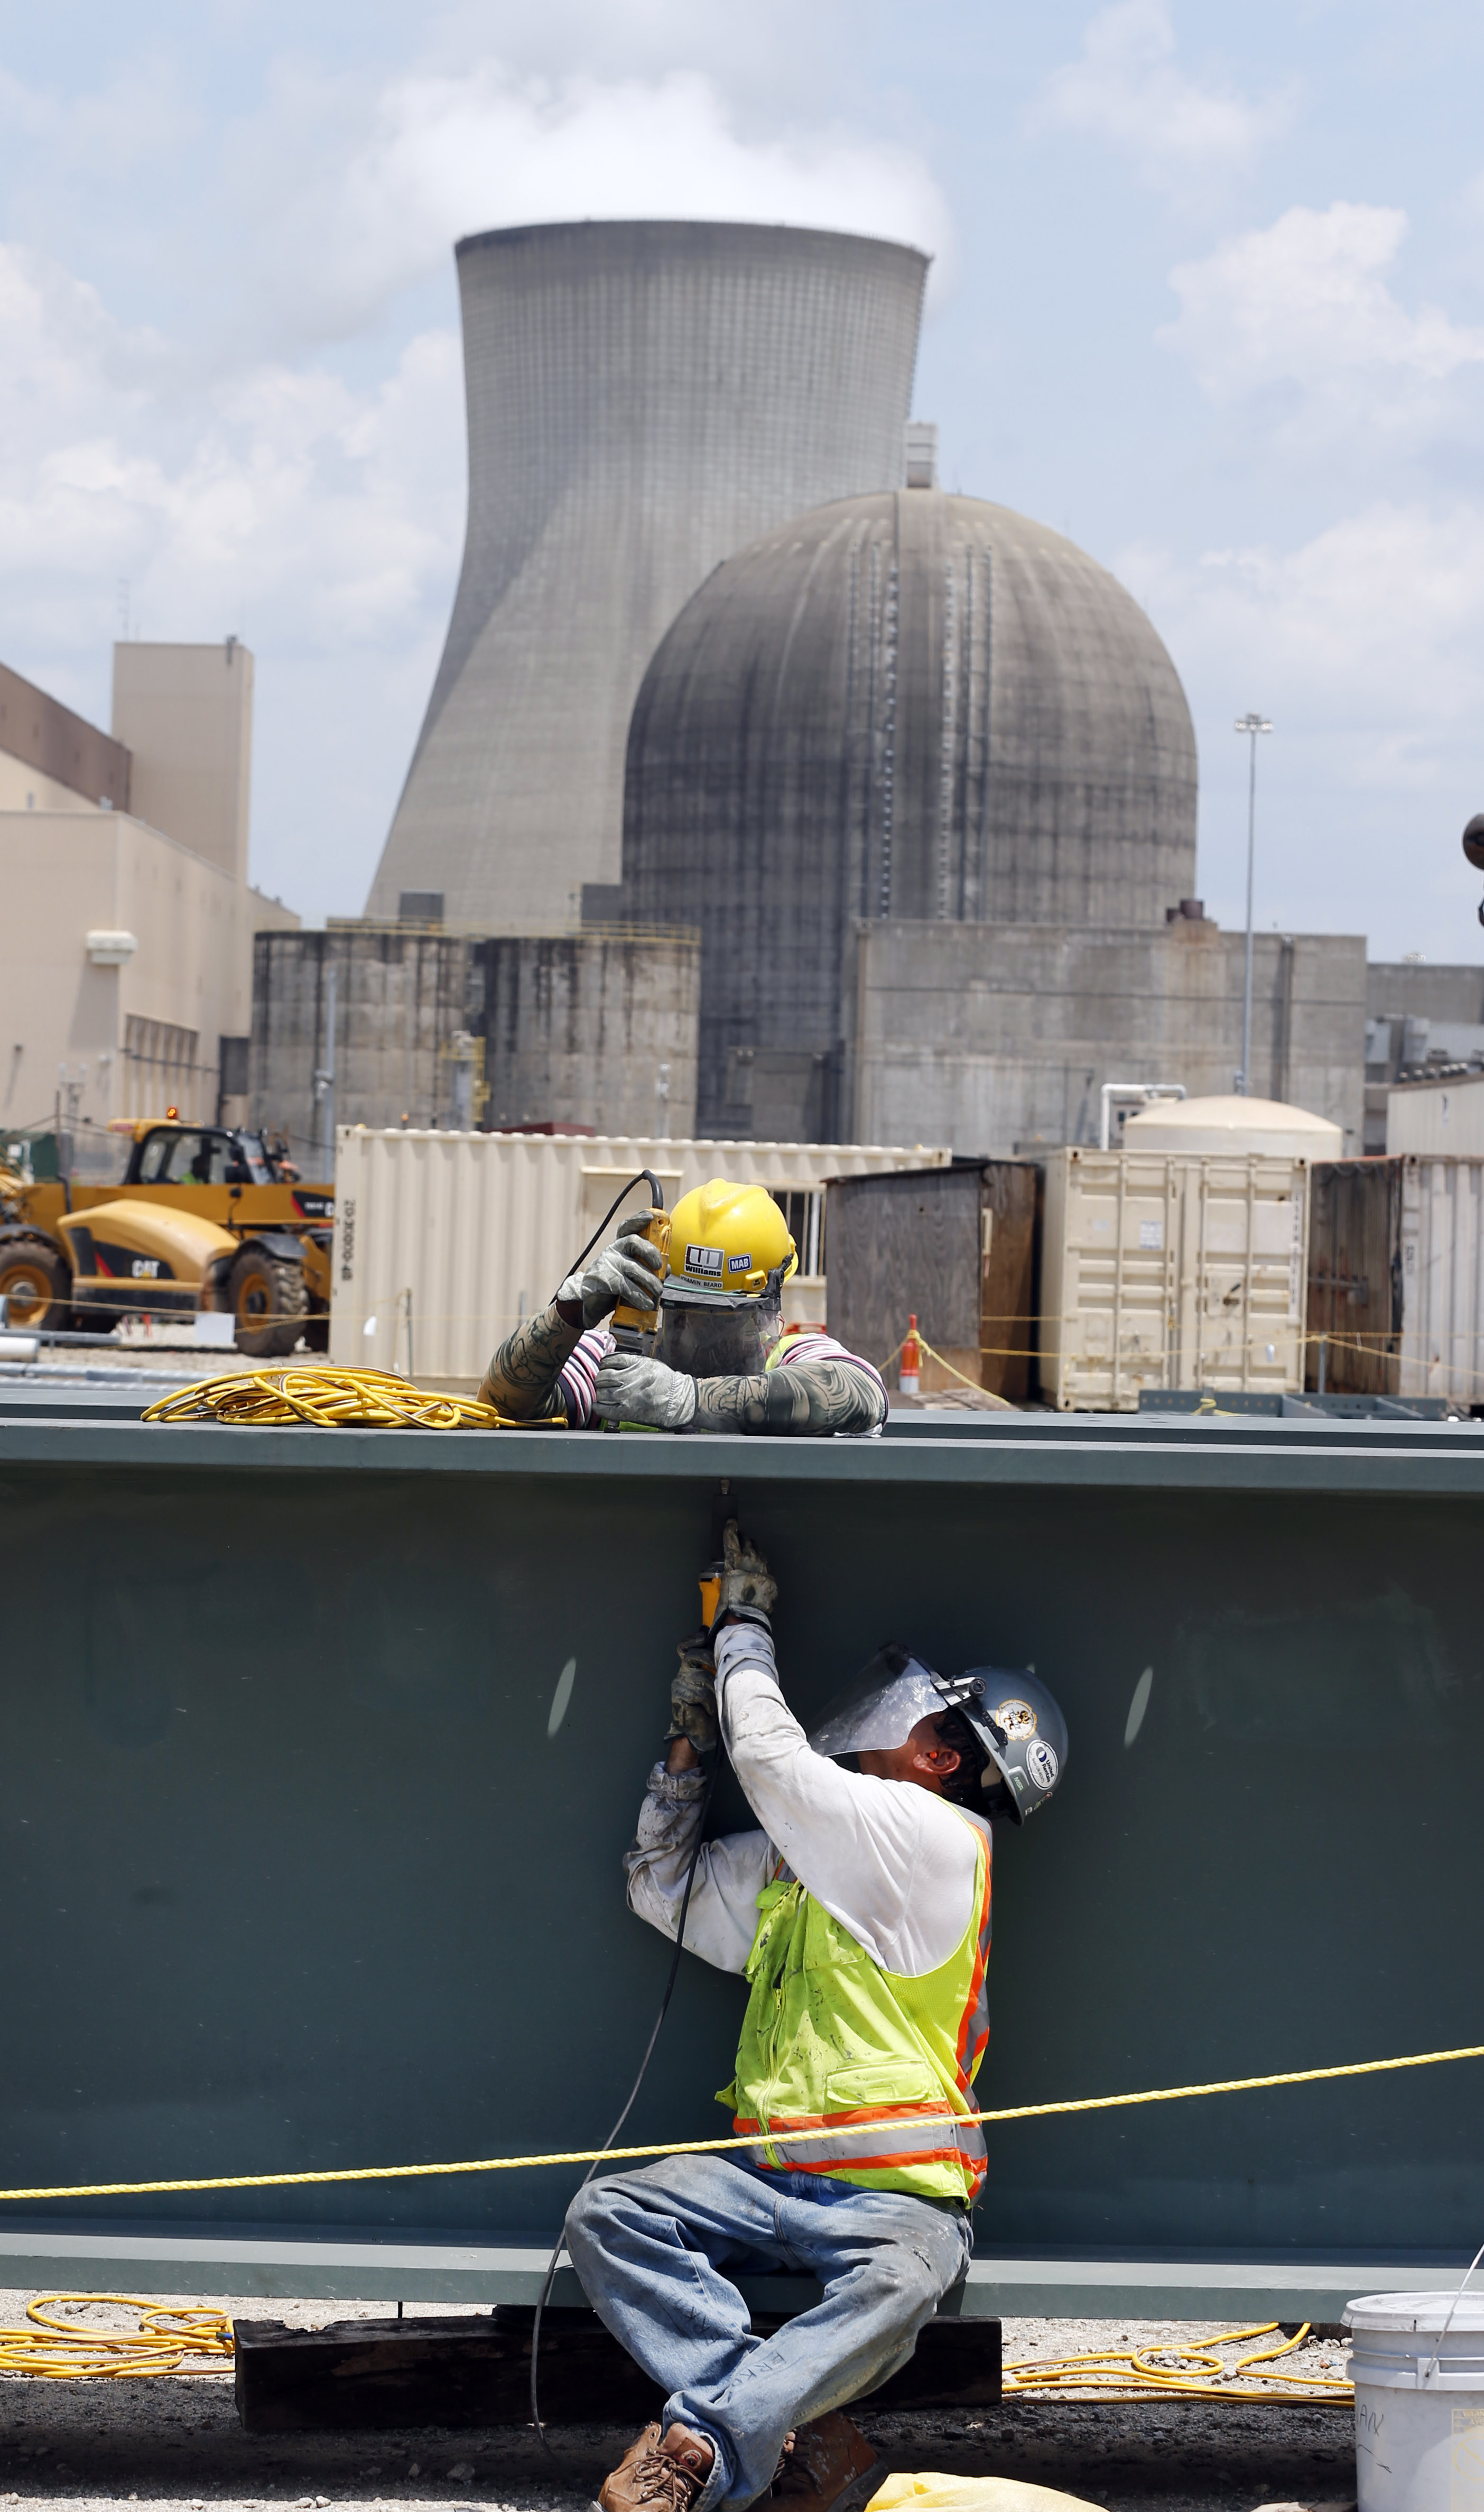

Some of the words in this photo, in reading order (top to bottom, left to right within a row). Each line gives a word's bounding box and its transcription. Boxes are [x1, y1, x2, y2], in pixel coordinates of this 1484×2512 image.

[132, 1259, 160, 1278] CAT
[685, 1265, 721, 1277] Williams
[731, 1258, 749, 1270] MAB
[1042, 1763, 1051, 1783] Rentals
[1046, 1759, 1054, 1777] United
[1013, 1776, 1024, 1791] MSA
